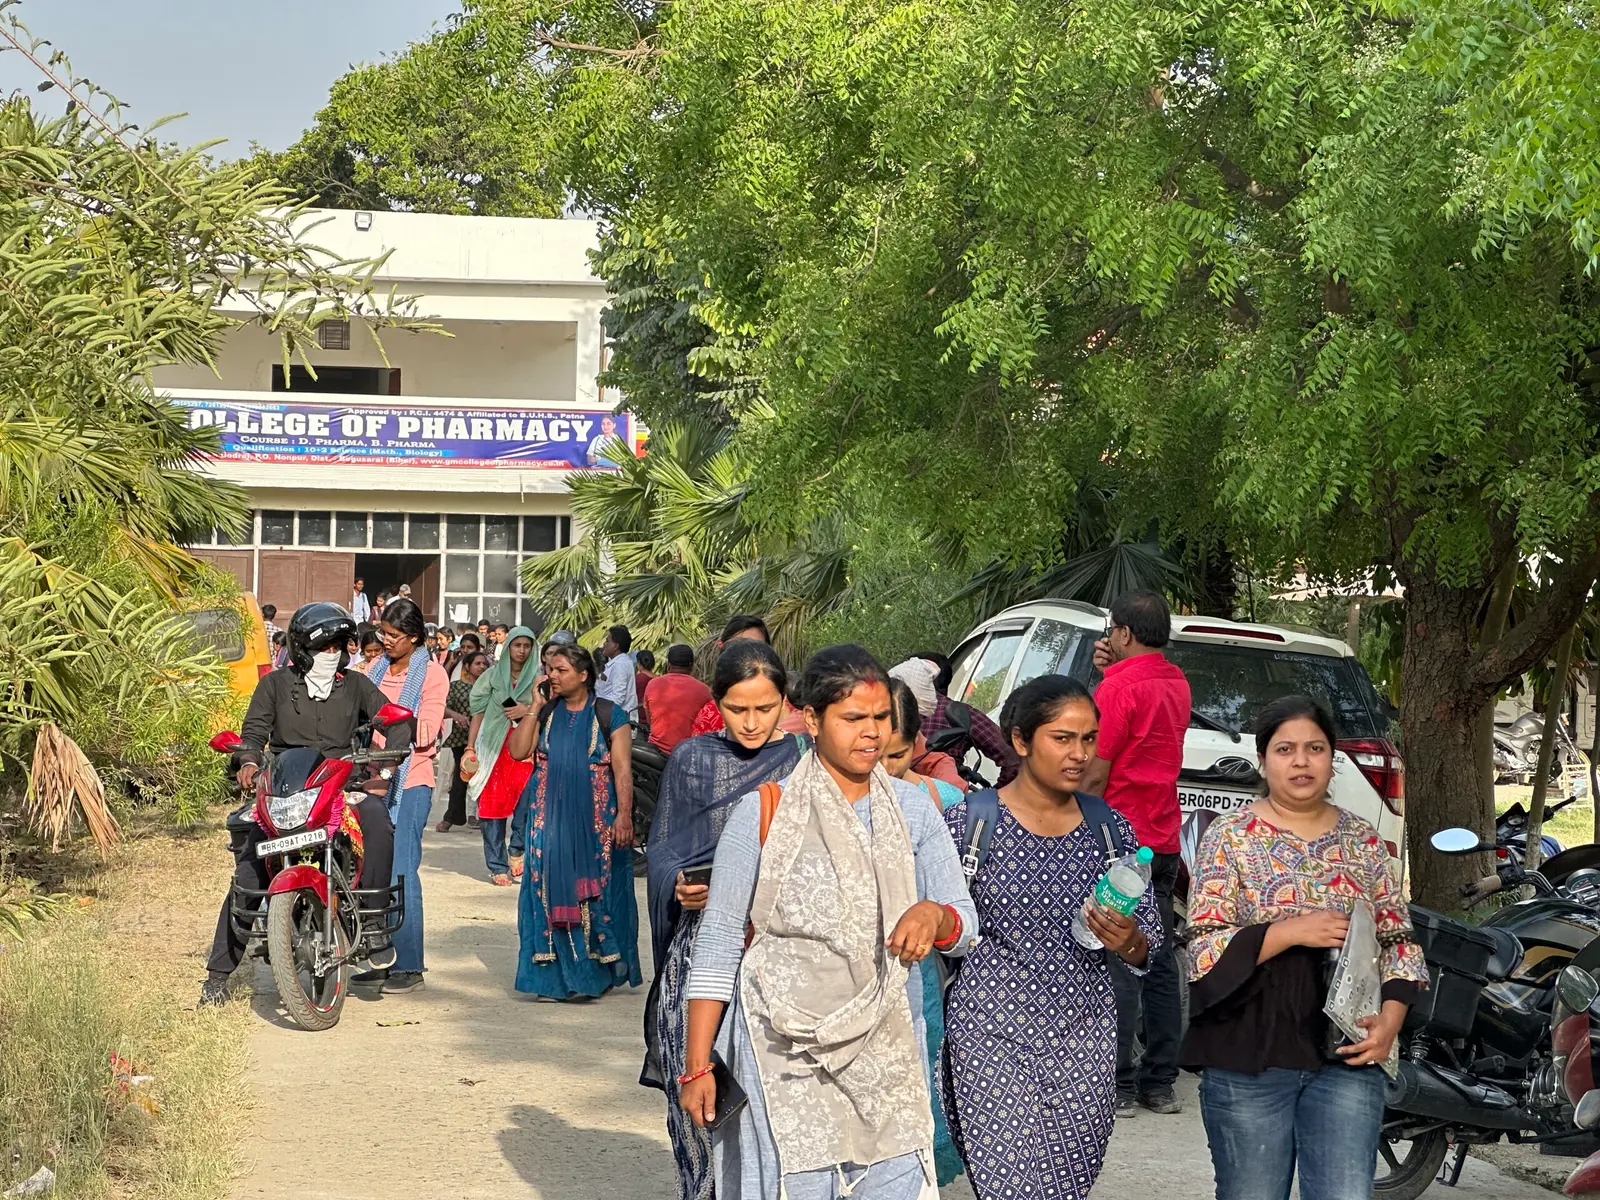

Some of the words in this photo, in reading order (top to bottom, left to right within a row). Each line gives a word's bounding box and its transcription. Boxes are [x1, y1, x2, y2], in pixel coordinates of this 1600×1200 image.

[348, 408, 389, 416] Approved
[391, 409, 402, 417] by
[180, 409, 330, 436] OLLEGE
[341, 414, 387, 437] OF
[398, 416, 593, 442] PHARMACY
[298, 437, 312, 446] D.
[387, 440, 436, 448] PHARMA
[232, 444, 295, 453] Qualification
[330, 447, 367, 455] Science
[405, 449, 443, 457] Biology)
